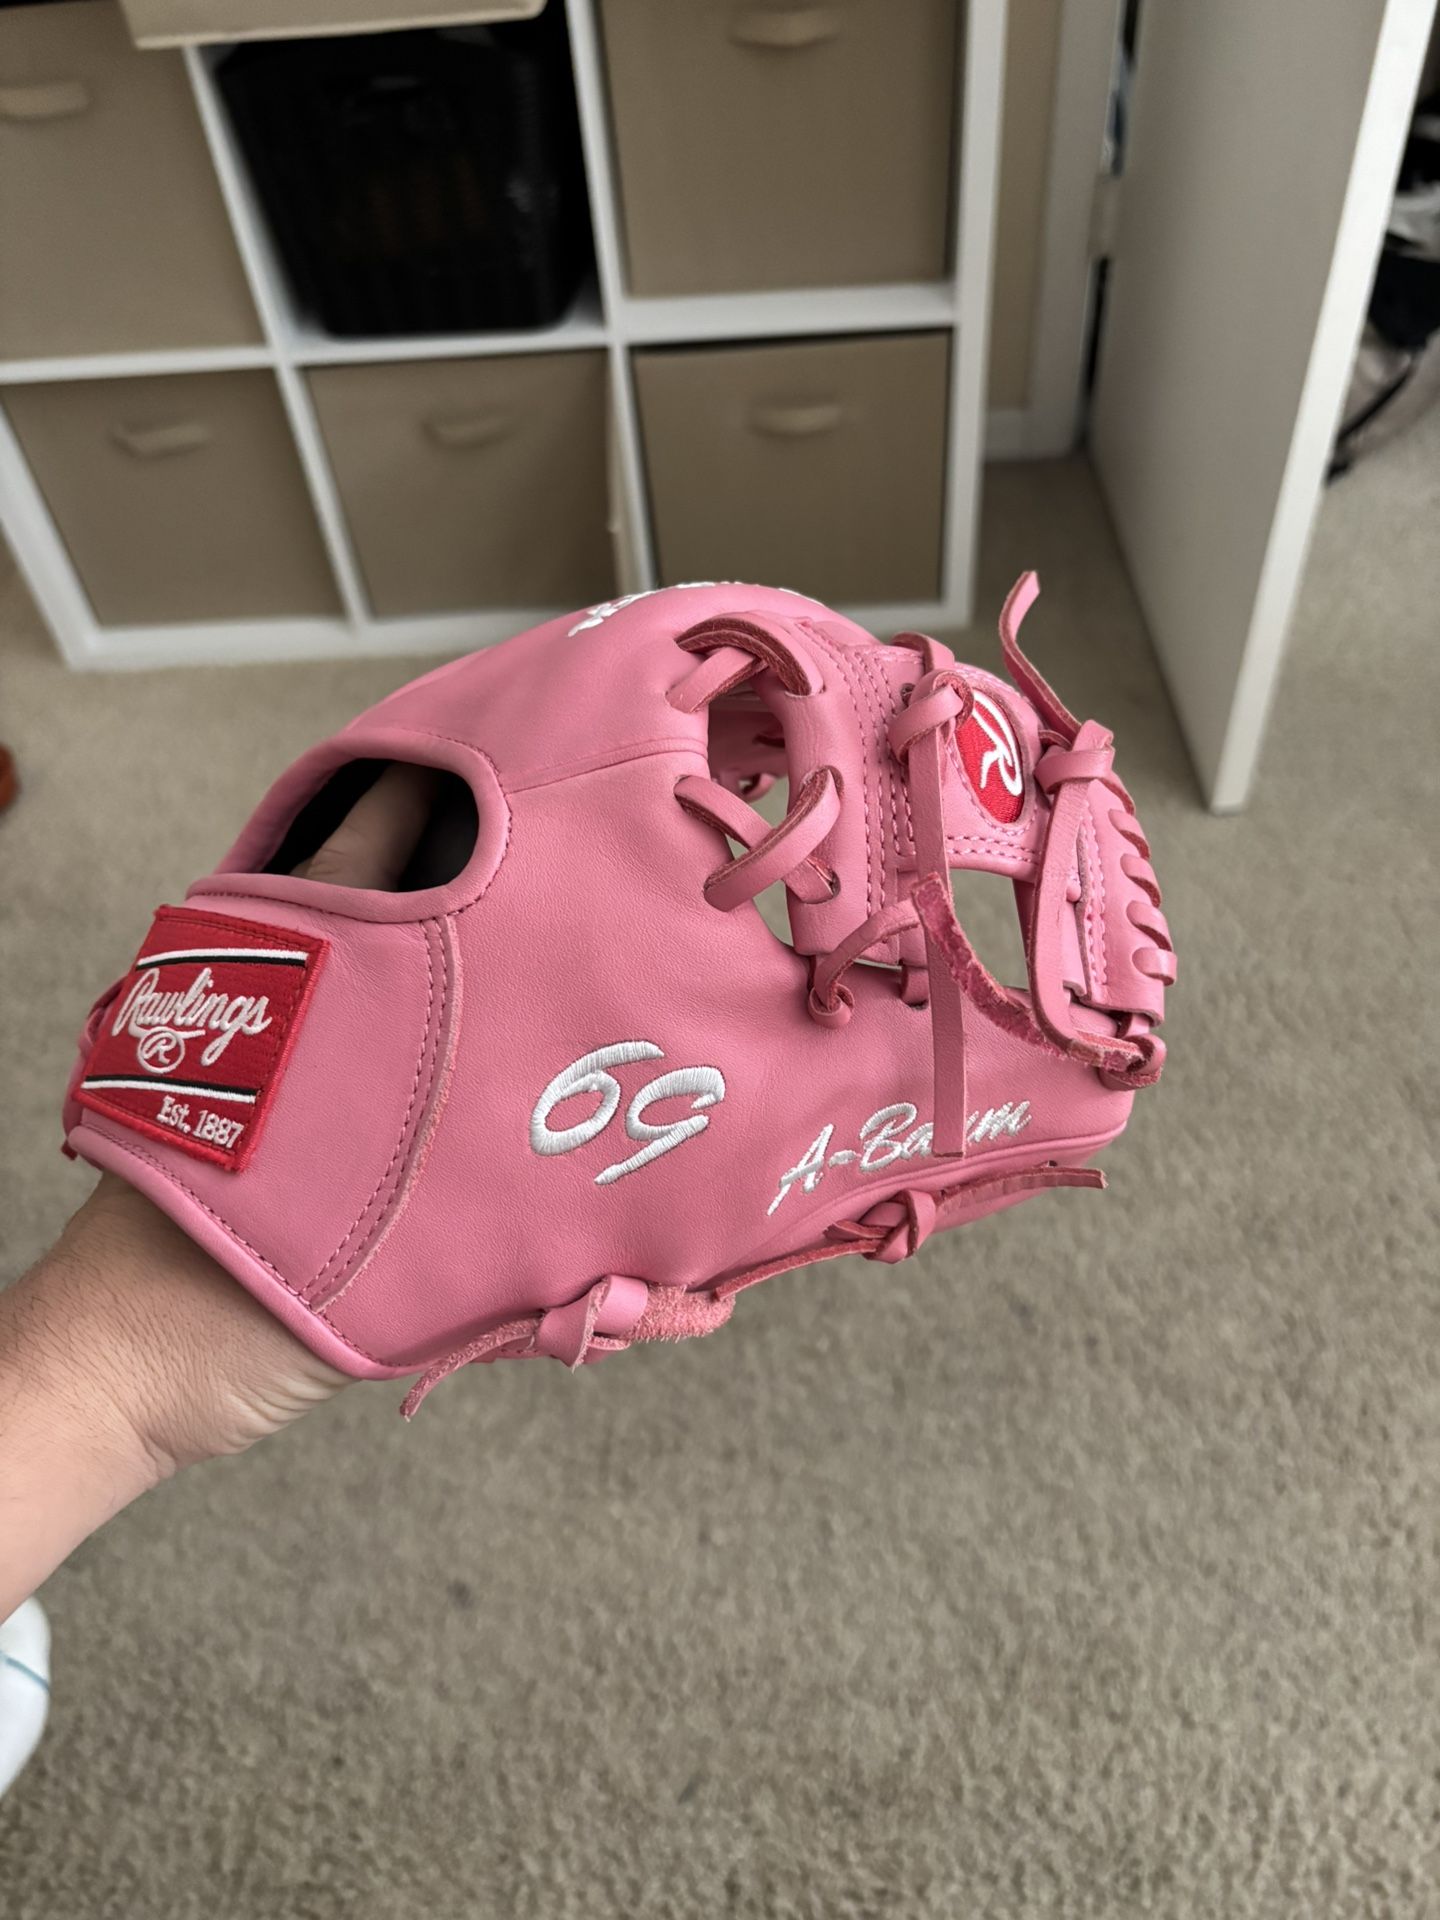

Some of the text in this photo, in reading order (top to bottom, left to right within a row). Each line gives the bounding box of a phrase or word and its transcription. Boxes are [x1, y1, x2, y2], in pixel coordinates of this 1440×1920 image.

[111, 967, 273, 1067] Rawlings
[156, 1096, 245, 1149] Est. 1887
[529, 1039, 726, 1186] 69
